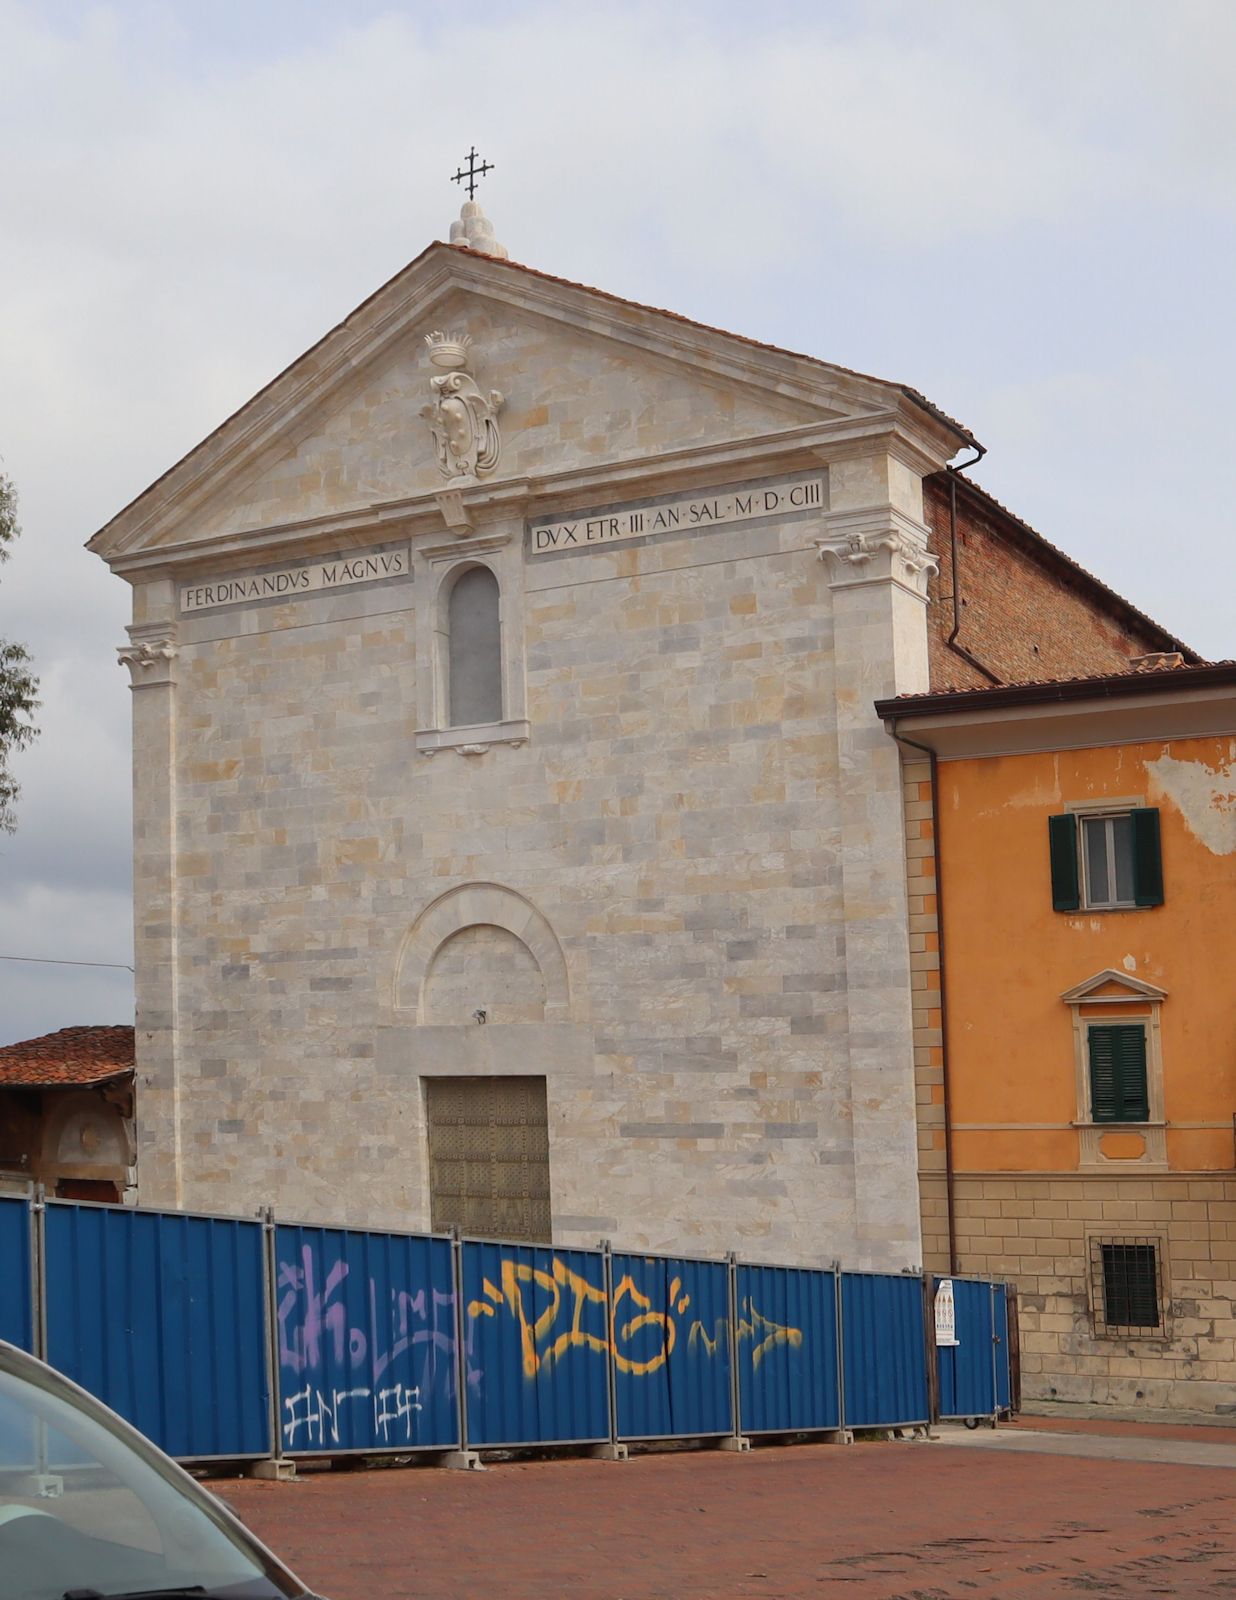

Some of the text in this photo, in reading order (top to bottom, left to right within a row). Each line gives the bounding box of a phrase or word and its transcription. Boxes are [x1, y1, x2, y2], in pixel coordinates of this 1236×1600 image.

[536, 524, 578, 549] DVX
[789, 483, 820, 506] CIII
[186, 553, 403, 608] FERDINANDVS MAGNVS
